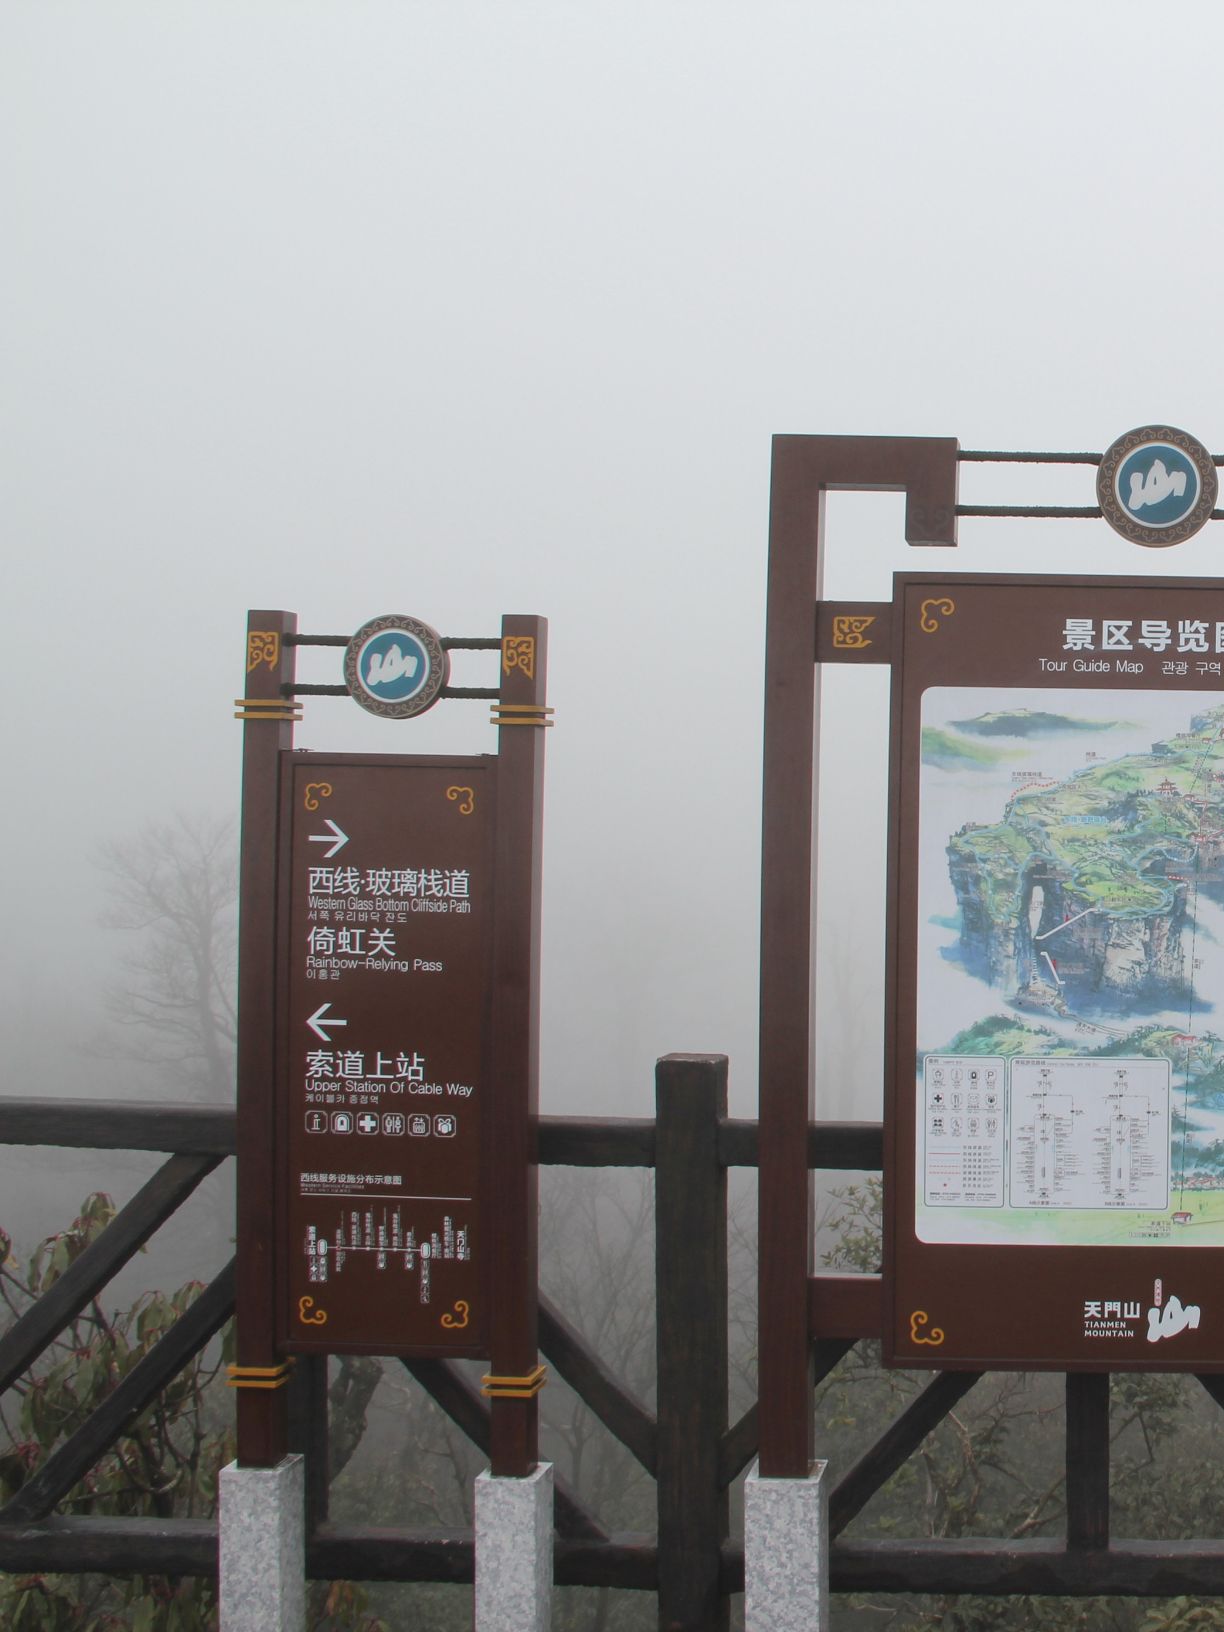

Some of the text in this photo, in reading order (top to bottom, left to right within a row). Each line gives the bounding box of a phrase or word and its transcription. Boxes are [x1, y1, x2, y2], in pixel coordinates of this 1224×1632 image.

[1039, 658, 1143, 674] Tour Guide Map
[1162, 662, 1188, 674] 관광
[1196, 662, 1221, 675] 구역
[308, 897, 470, 914] Western Glass Bottom Cliffside Path
[307, 926, 396, 956] 倚虹关
[307, 957, 442, 972] Rainbow-Relying Pass
[306, 1050, 424, 1081] 索道上站
[306, 1080, 472, 1097] Upper Station Of Cable Way
[300, 1173, 402, 1184] 西线服务设施分布示意图
[1084, 1301, 1140, 1318] 天門山
